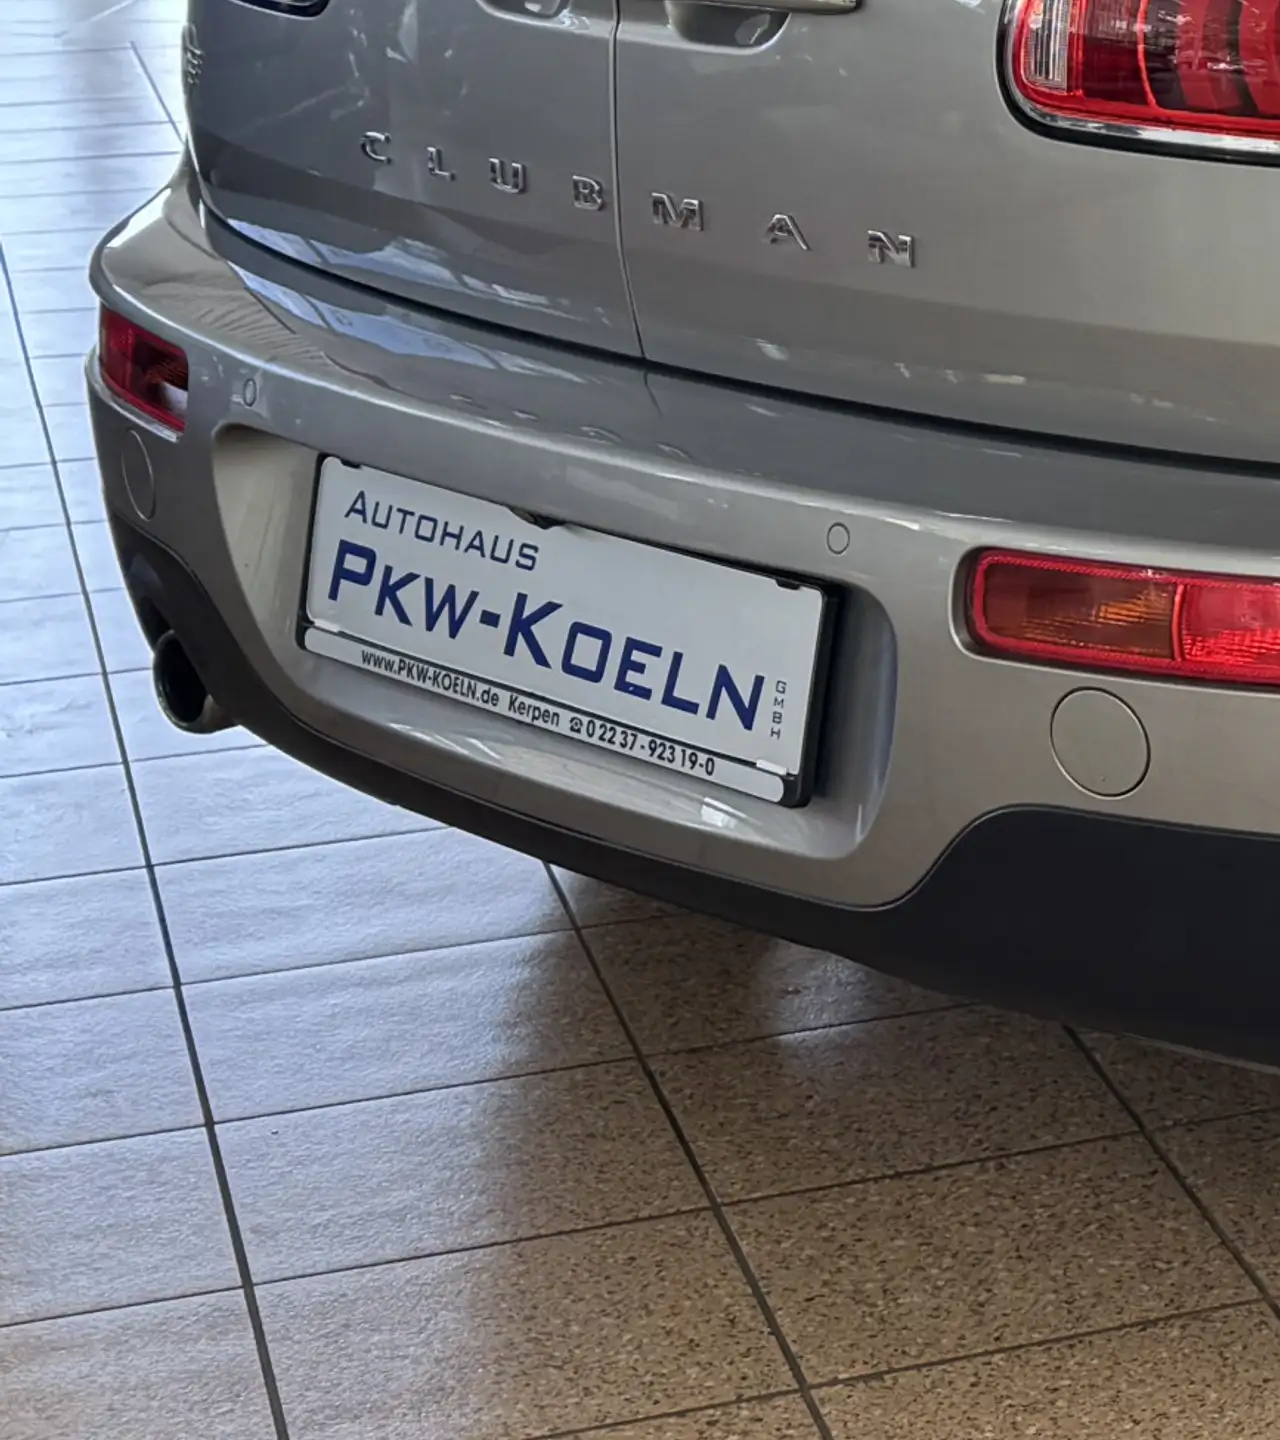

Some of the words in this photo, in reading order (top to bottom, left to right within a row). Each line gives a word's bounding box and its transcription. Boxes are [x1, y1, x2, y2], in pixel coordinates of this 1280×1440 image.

[360, 131, 916, 268] CLUBMAN
[344, 490, 539, 571] AUTOHAUS
[328, 538, 765, 732] PKW-KOELN
[361, 649, 499, 707] www.PKW-KOELN.de
[508, 693, 561, 727] Kerpen
